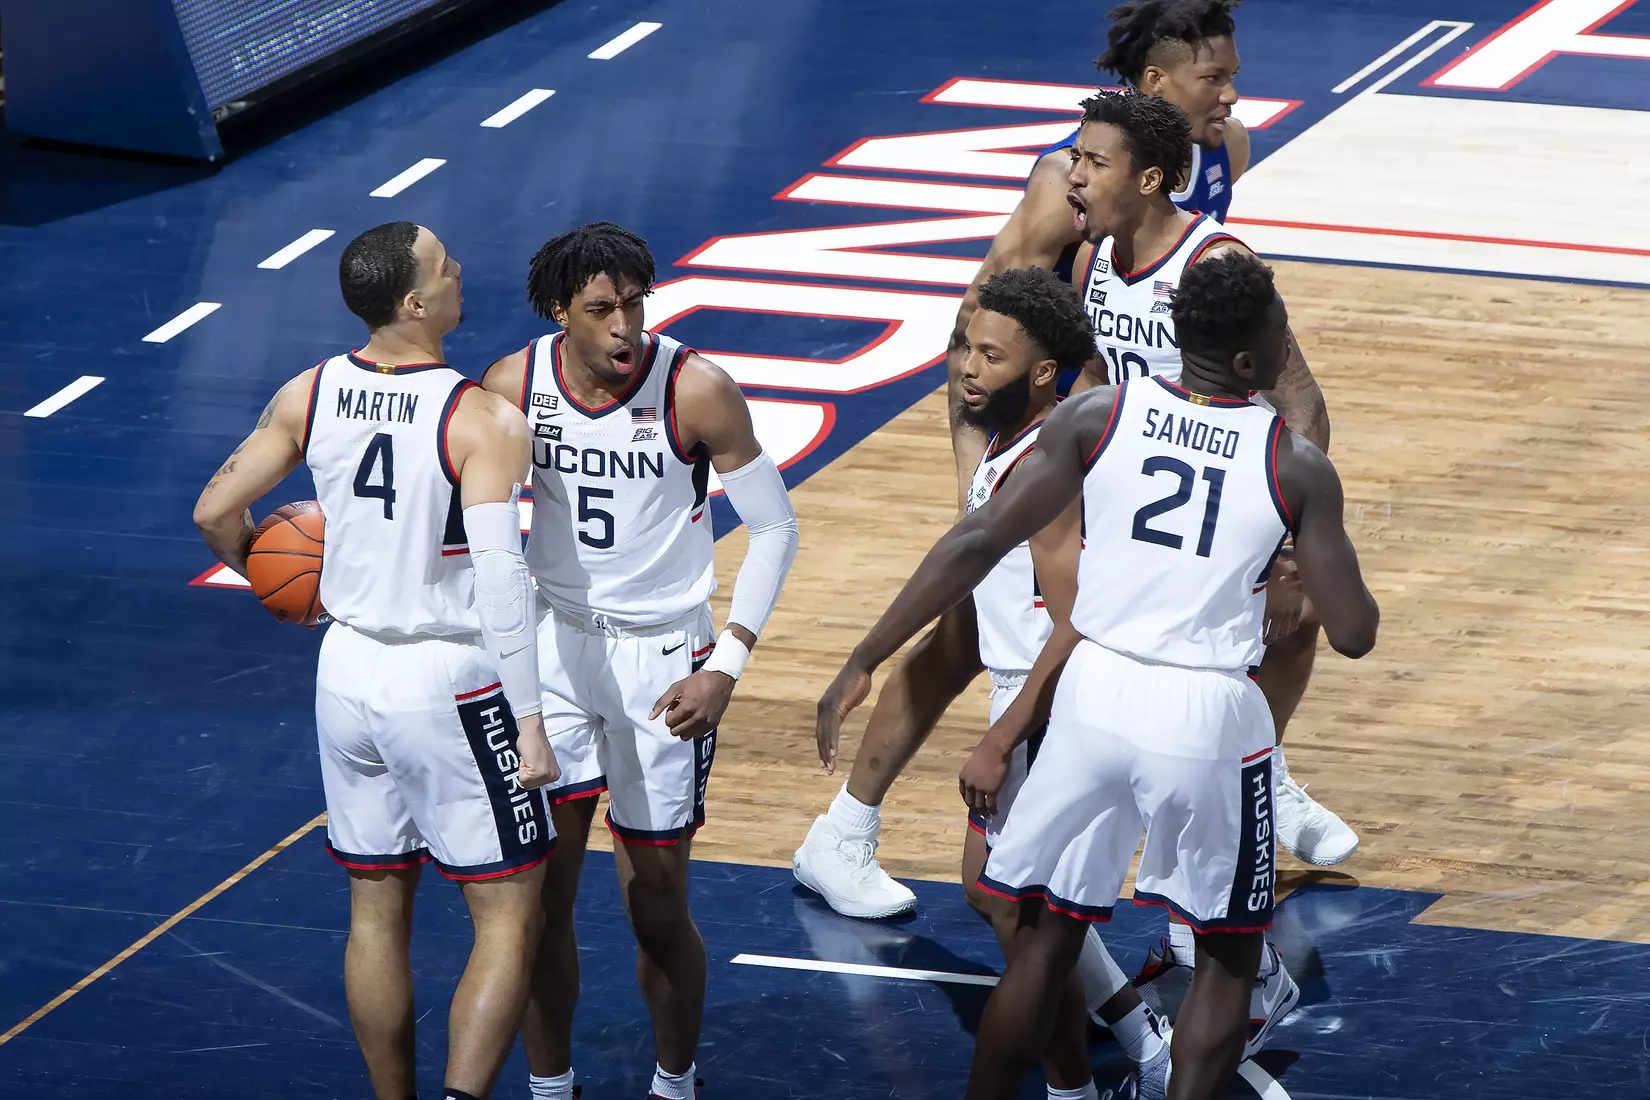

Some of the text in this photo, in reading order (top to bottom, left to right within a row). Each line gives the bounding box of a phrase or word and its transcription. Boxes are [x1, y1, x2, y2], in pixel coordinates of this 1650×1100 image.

[337, 387, 419, 424] MARTIN
[533, 393, 557, 409] DEE
[538, 425, 561, 437] BLM
[632, 432, 658, 441] EAST
[1142, 408, 1240, 460] SANOGO
[353, 432, 396, 521] 4
[532, 440, 664, 479] UCONN
[577, 485, 615, 549] 5
[1131, 455, 1226, 558] 21
[480, 705, 538, 845] HUSKIES
[1247, 772, 1270, 911] HUSKIES
